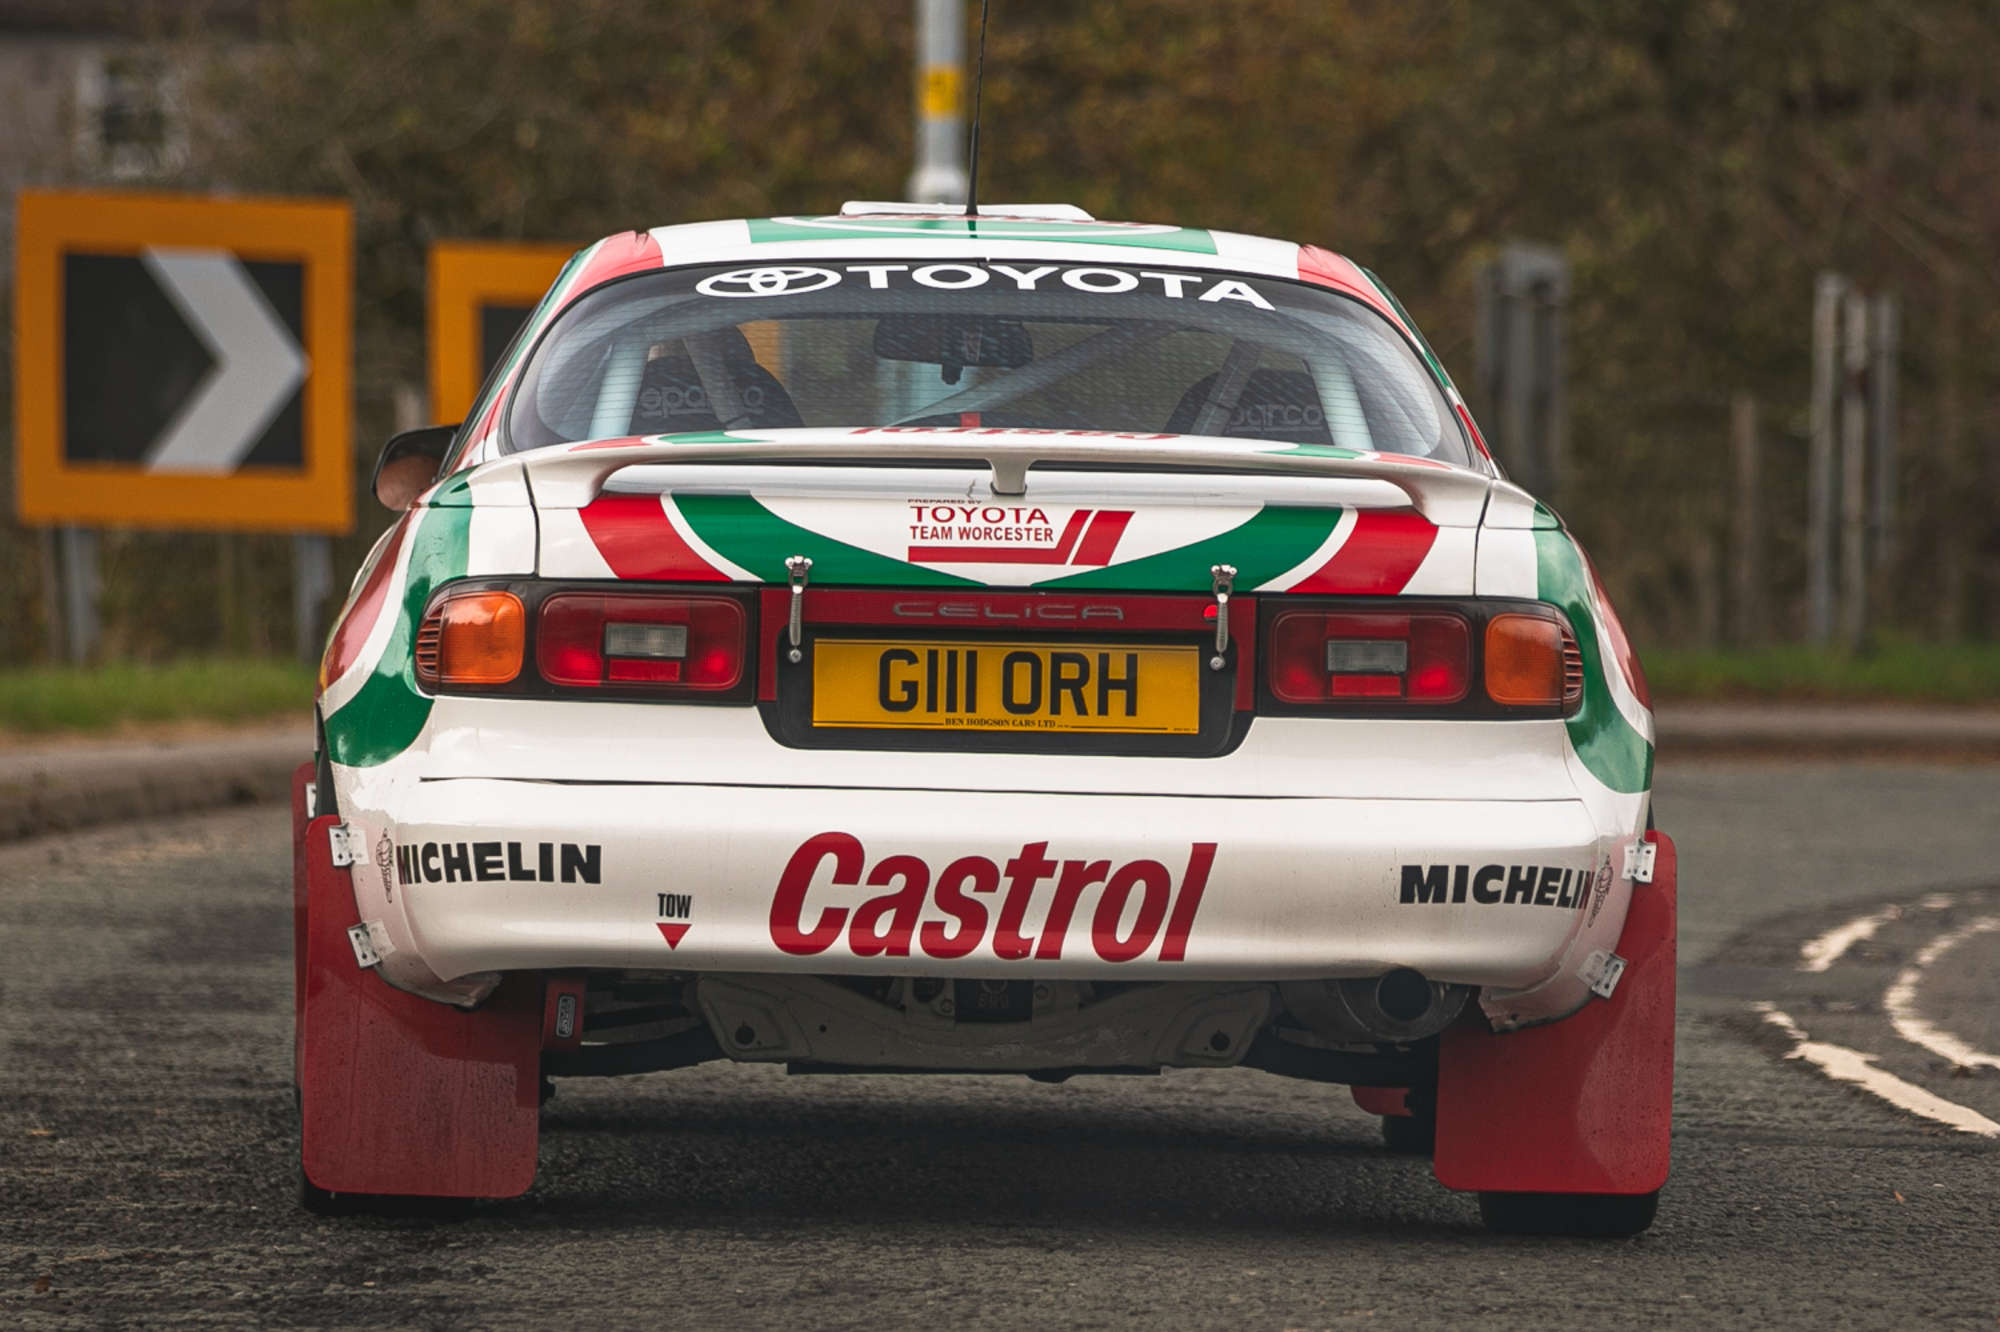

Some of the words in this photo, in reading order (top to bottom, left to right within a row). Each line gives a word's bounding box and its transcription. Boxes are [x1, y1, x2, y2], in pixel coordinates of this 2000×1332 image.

[847, 264, 1276, 311] TOYOTA
[910, 506, 1050, 525] TOYOTA
[910, 525, 953, 541] TEAM
[958, 526, 1054, 542] WORCESTER
[892, 601, 1125, 621] CELICA
[945, 717, 964, 726] BEN
[966, 718, 1010, 728] HODGSON
[1012, 719, 1036, 729] CARS
[1038, 719, 1056, 729] LTD
[396, 842, 602, 885] MICHELIN
[769, 831, 1218, 963] Castrol
[1400, 864, 1595, 910] MICHELIN
[658, 893, 692, 919] TOW
